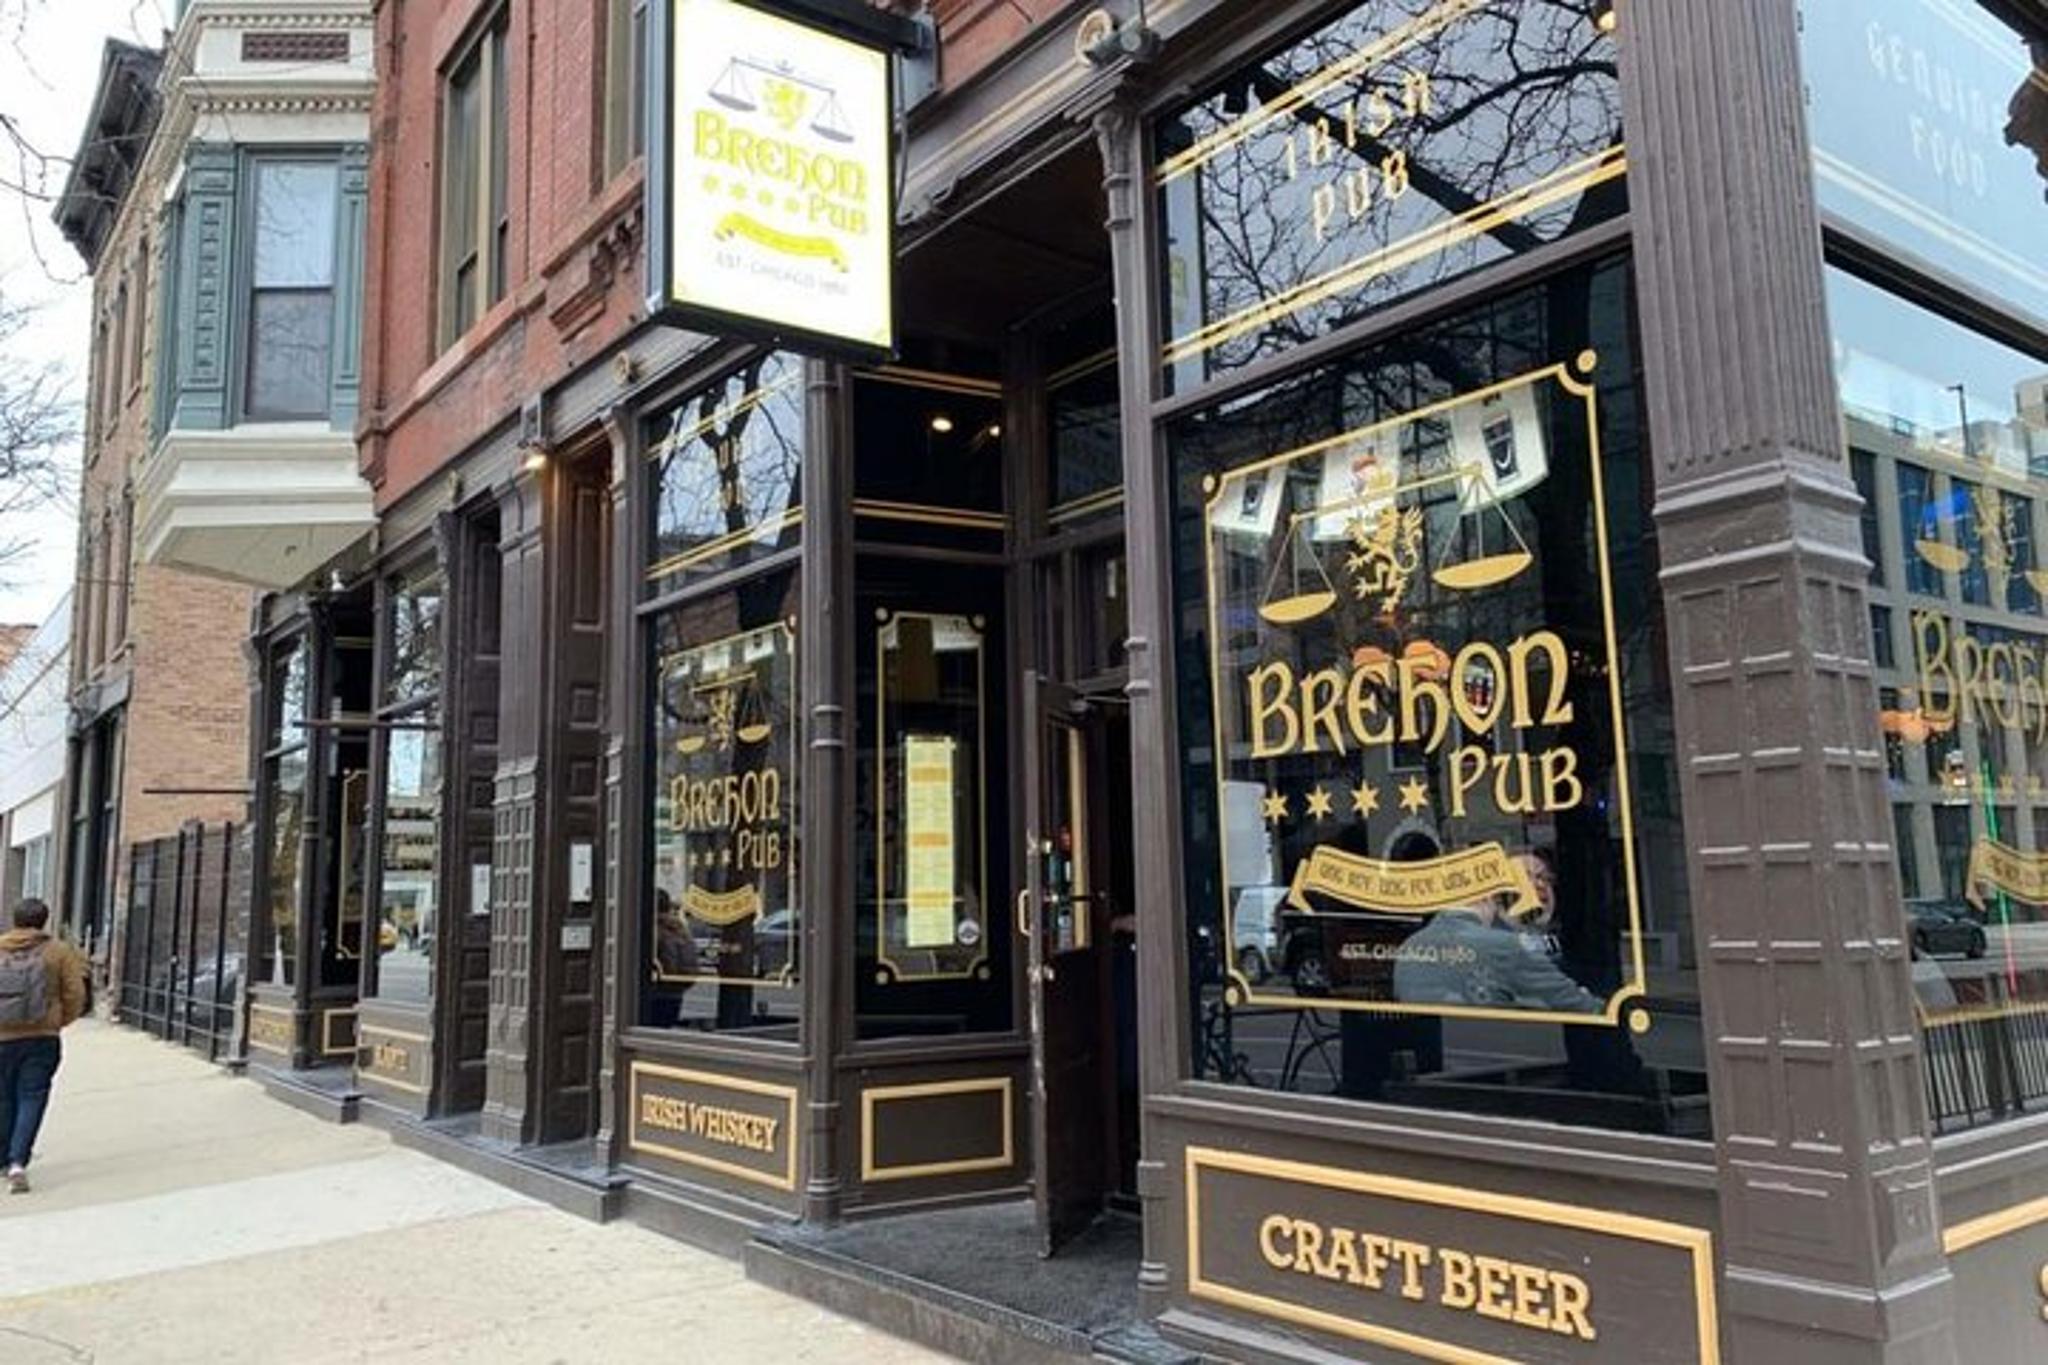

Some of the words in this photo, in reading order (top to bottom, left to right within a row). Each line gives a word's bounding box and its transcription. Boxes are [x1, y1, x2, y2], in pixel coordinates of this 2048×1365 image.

[1314, 150, 1410, 243] PUB
[1912, 608, 2048, 747] BREH
[1449, 746, 1583, 817] PUB
[737, 831, 781, 871] PUB
[642, 1093, 687, 1132] IRISH
[687, 1101, 778, 1152] WHISKEY
[1260, 1214, 1431, 1300] CRAFT
[1438, 1248, 1597, 1341] BEER
